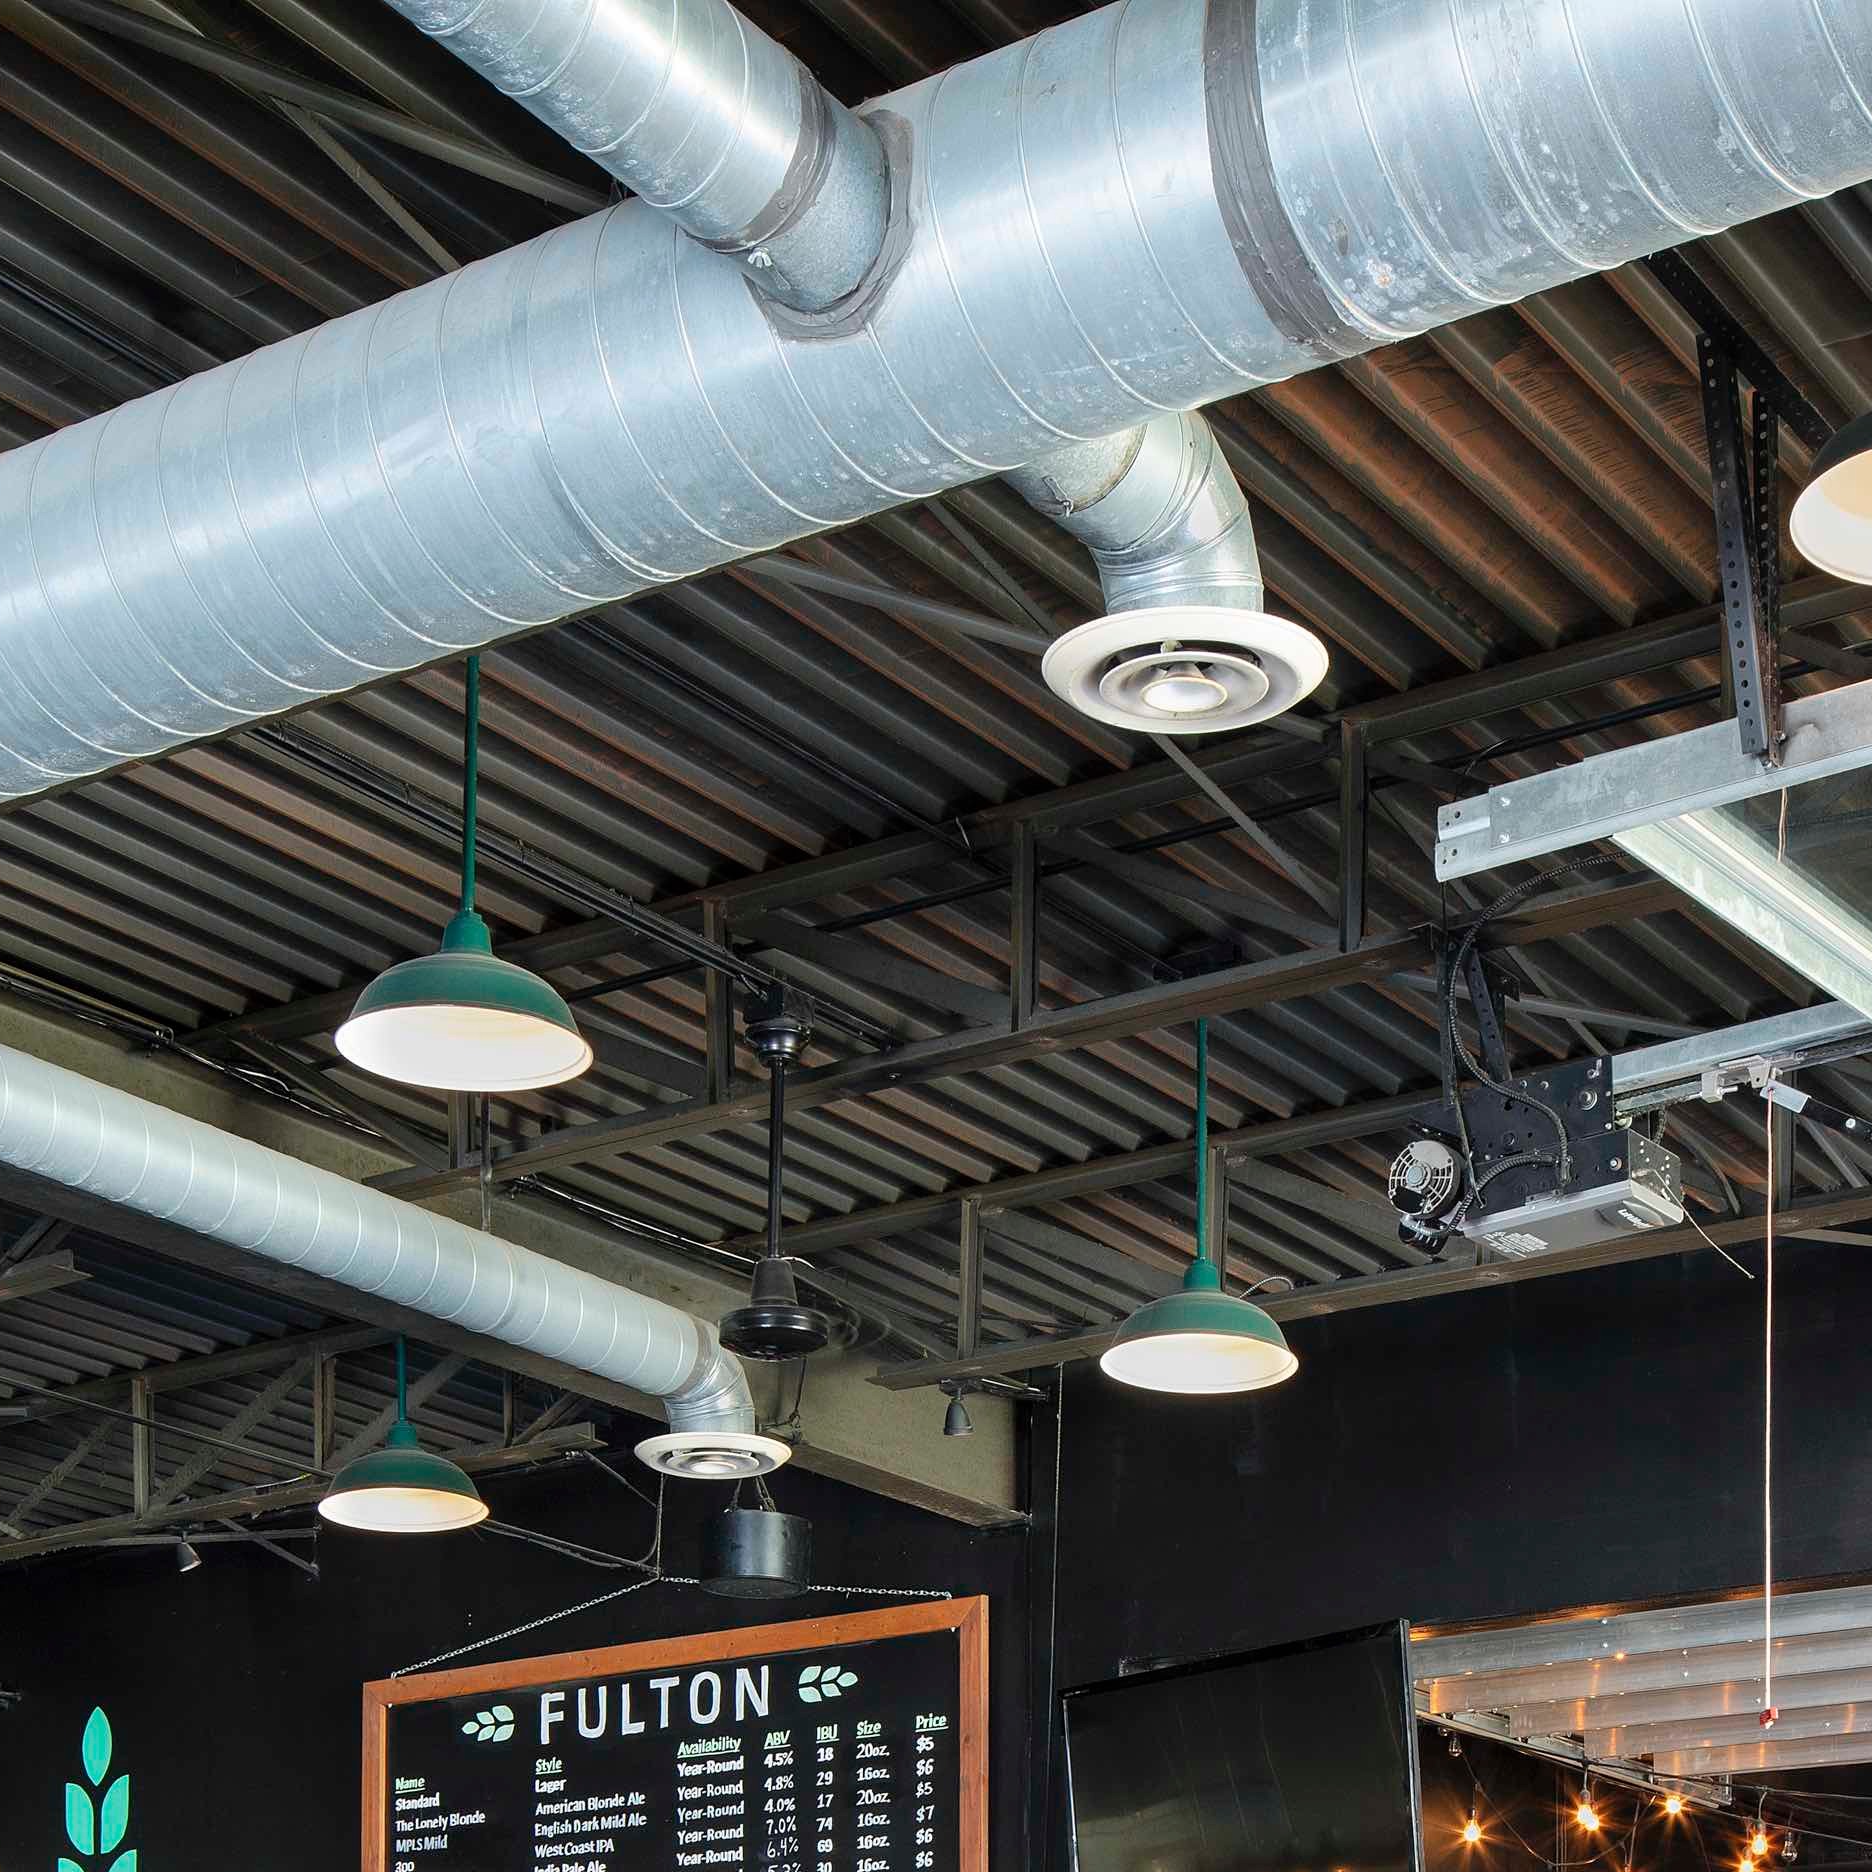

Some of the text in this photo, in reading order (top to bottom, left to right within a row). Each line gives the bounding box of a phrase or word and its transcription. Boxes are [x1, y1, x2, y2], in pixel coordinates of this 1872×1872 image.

[539, 1664, 769, 1746] FULTON
[394, 1712, 947, 1790] Name Style Availability ABV IBU Size Price
[395, 1735, 934, 1811] Standard Lager Year-Round 20oz. $5
[395, 1759, 934, 1831] The Lonely Blonde American Blonde Ale Year-Round 16oz. $6
[396, 1782, 933, 1852] MPLS Mild English Dark Mild Ale Year-Round 20oz. $5
[535, 1844, 564, 1858] West
[564, 1841, 595, 1856] Coast
[596, 1838, 614, 1853] IPA
[677, 1824, 744, 1845] Year-Round
[857, 1813, 890, 1827] 16oz.
[916, 1805, 934, 1823] $7
[677, 1846, 743, 1865] Year-Round
[857, 1835, 890, 1849] 16oz.
[916, 1828, 933, 1845] $6
[857, 1858, 889, 1872] 16oz.
[916, 1851, 933, 1868] $6
